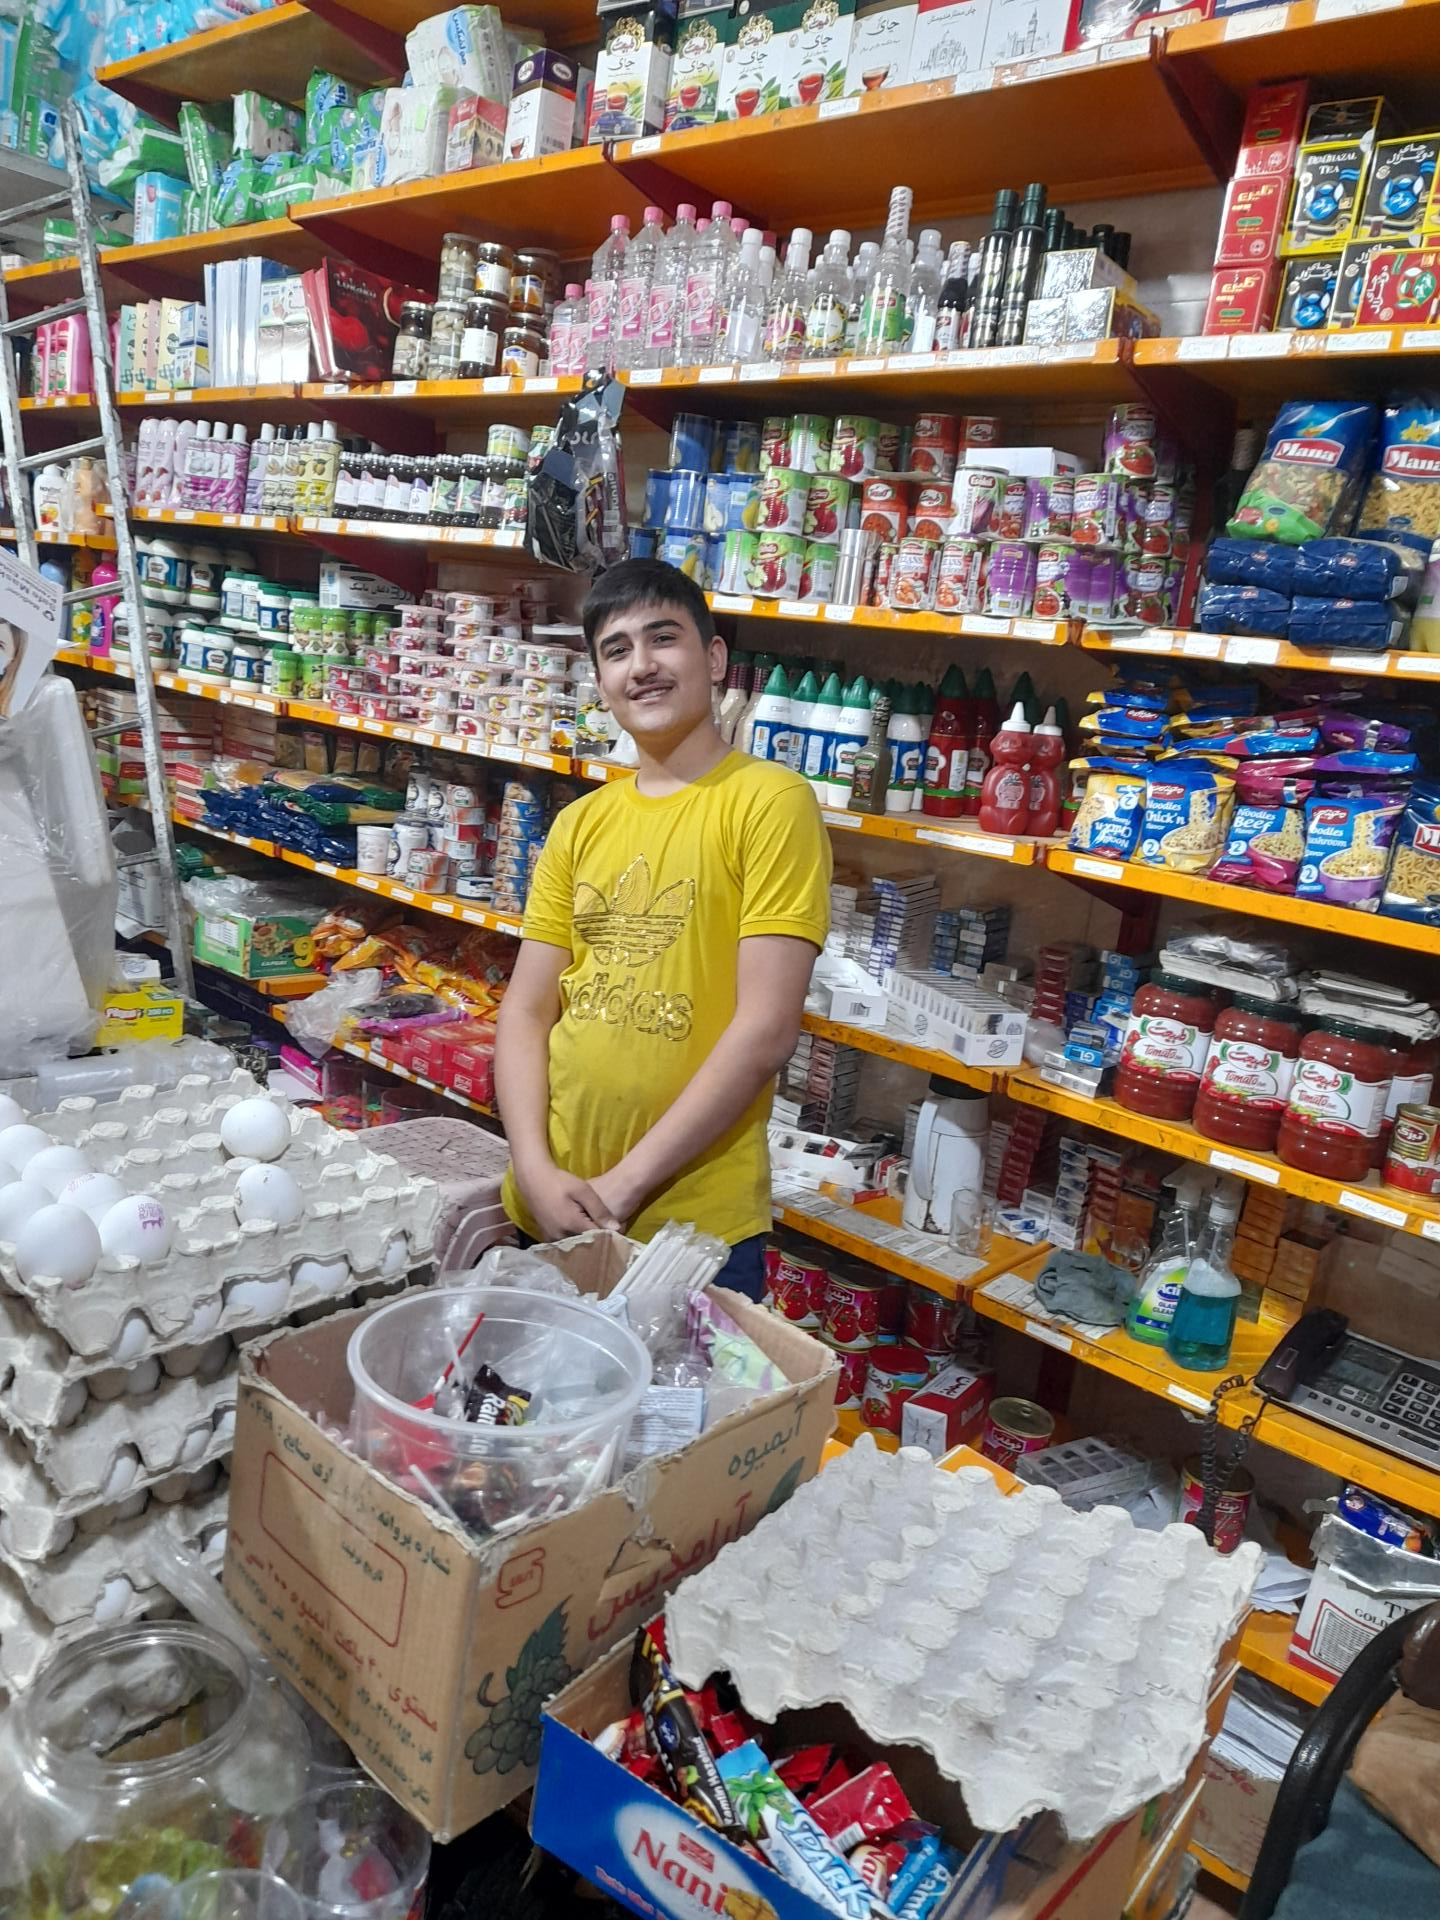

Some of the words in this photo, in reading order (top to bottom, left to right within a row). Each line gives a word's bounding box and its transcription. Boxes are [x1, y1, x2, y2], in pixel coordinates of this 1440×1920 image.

[1319, 165, 1340, 175] TEA
[1276, 443, 1337, 462] Mana
[1147, 799, 1182, 811] Noodles
[1238, 807, 1276, 820] Noodles
[1234, 816, 1274, 833] Beef
[293, 936, 315, 968] 9
[1148, 1025, 1188, 1043] طبیعت
[1143, 1044, 1178, 1059] Tomato
[1228, 1048, 1270, 1068] طبیعت
[1225, 1070, 1261, 1086] Tomato
[1302, 1068, 1341, 1090] طبیعت
[1297, 1091, 1330, 1107] Tomato
[727, 1400, 808, 1480] آبمیوه
[388, 1686, 438, 1733] محتوی
[632, 1827, 728, 1914] Nani
[776, 1809, 877, 1918] SPARK
